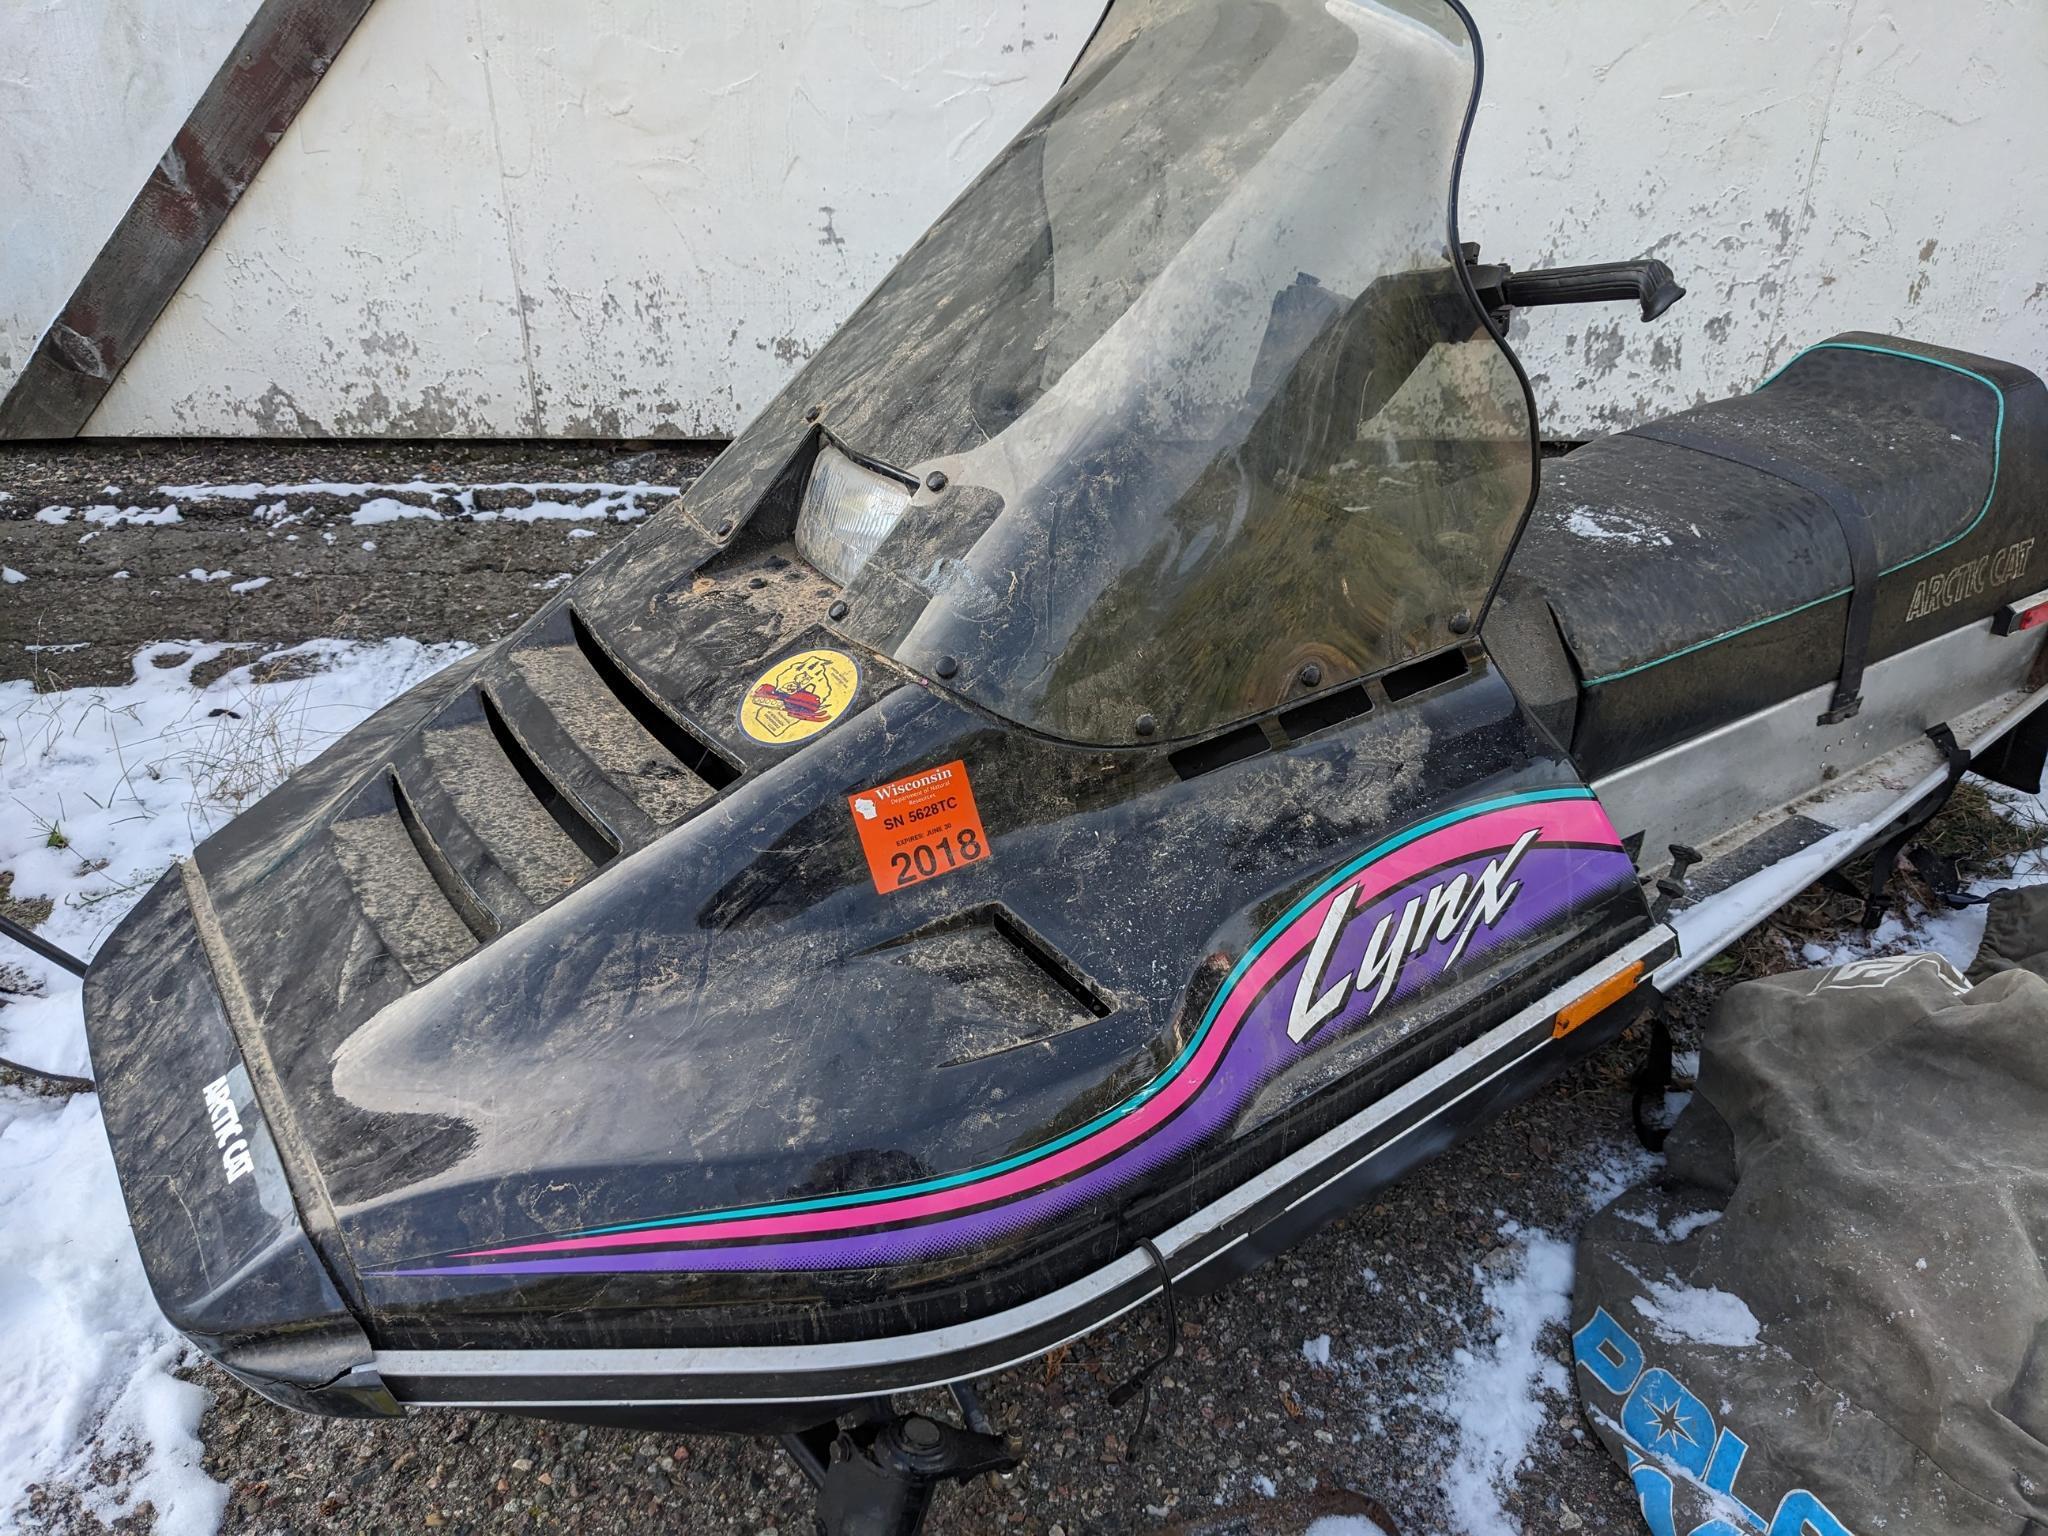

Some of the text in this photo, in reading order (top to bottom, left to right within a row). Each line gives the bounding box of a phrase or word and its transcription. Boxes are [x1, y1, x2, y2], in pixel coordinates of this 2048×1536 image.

[1905, 537, 2036, 622] ARCTIC CAT
[875, 768, 953, 801] Wisconsin
[890, 790, 923, 806] Department
[930, 780, 951, 791] Natural
[883, 796, 958, 831] SN 5628TC
[926, 826, 943, 837] JUNE
[943, 822, 952, 830] 30
[890, 828, 982, 886] 2018
[1286, 827, 1543, 1044] Lynx
[202, 1074, 255, 1185] ARCTIC CAT
